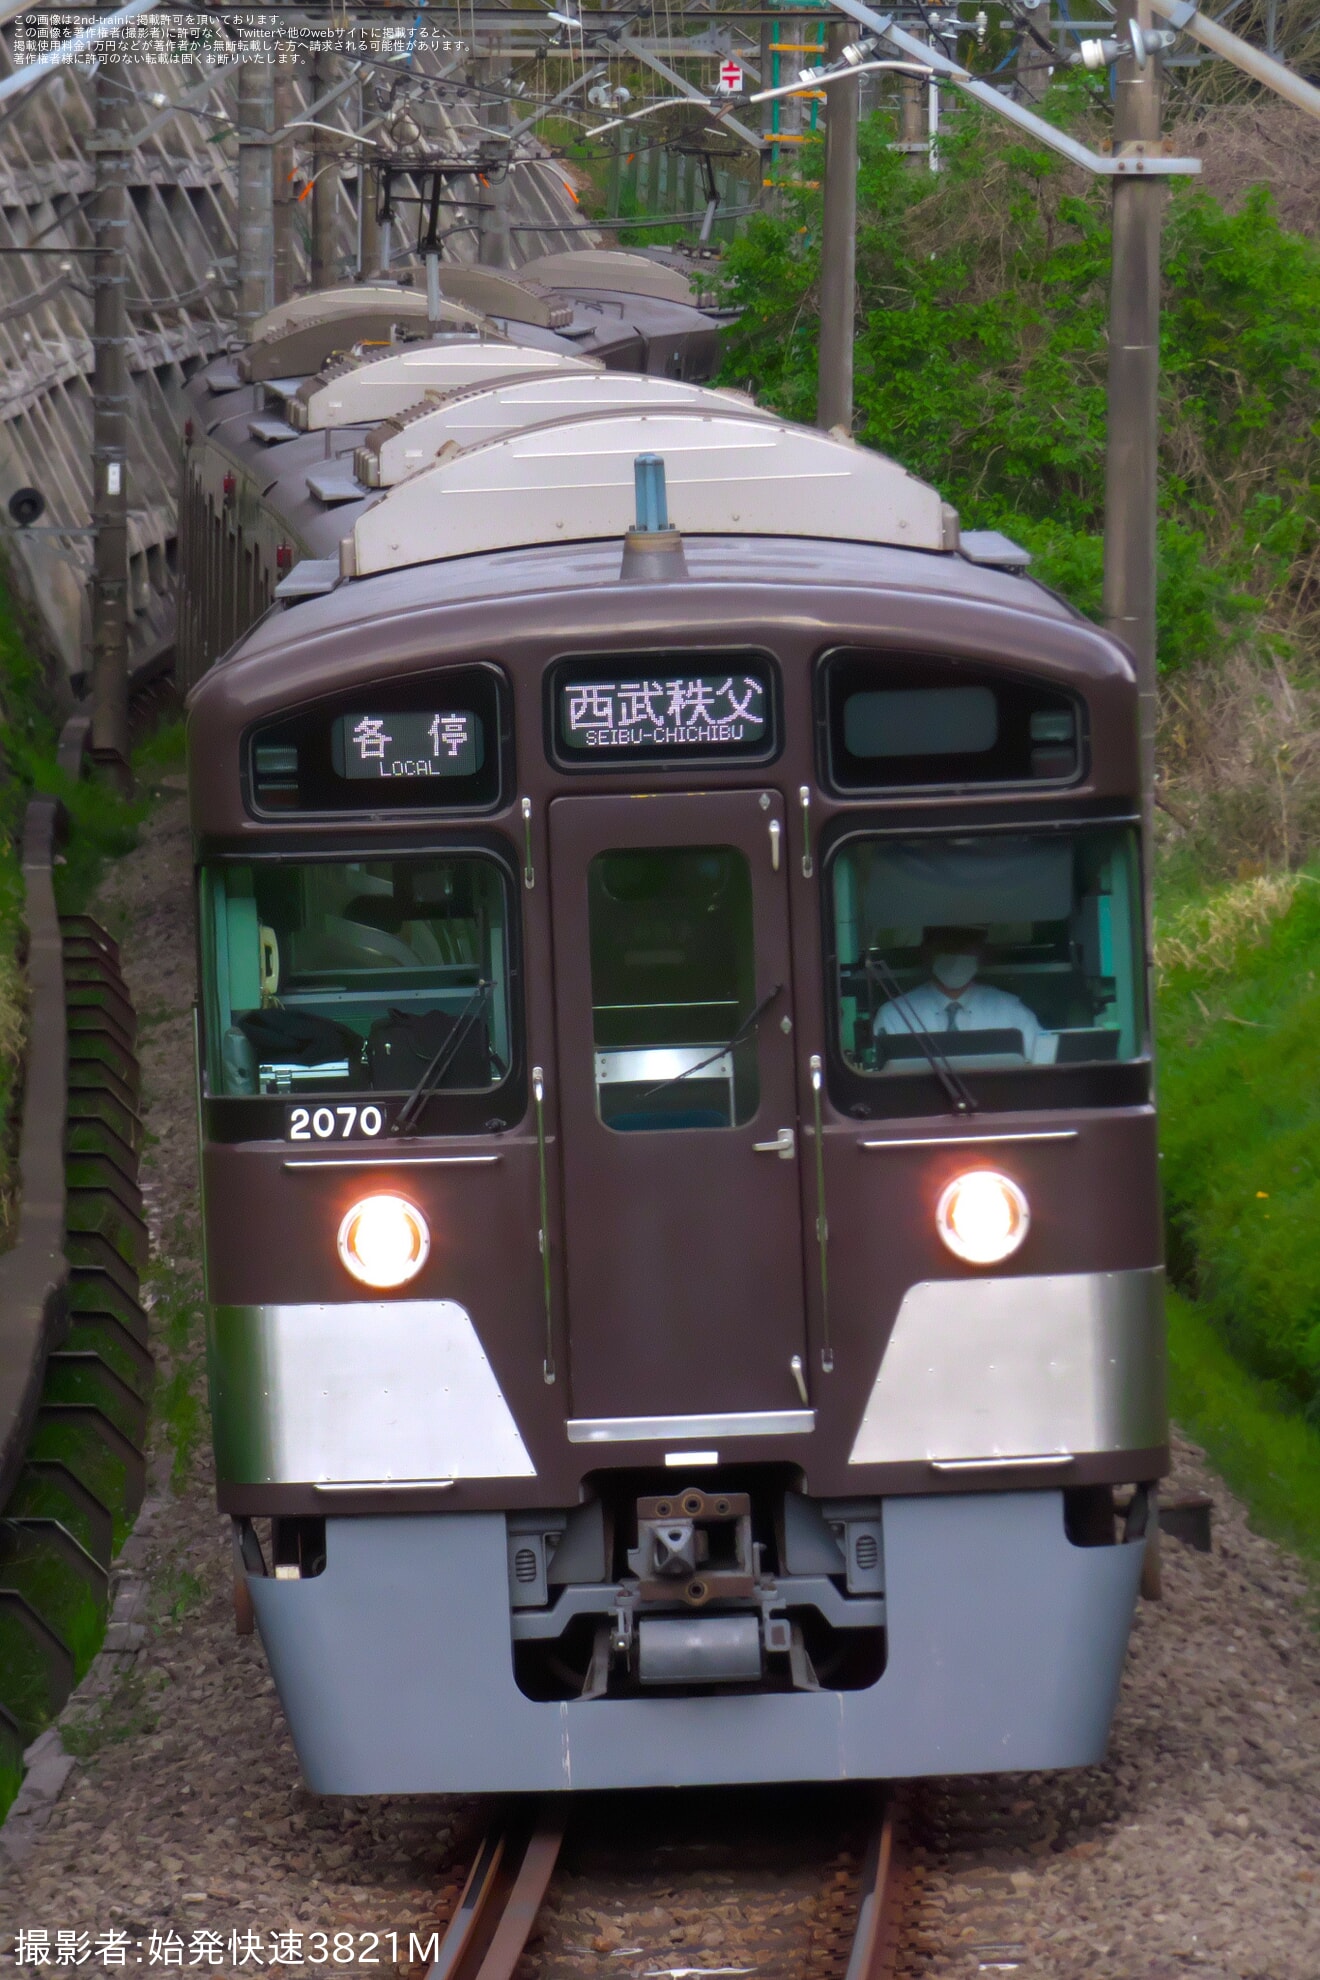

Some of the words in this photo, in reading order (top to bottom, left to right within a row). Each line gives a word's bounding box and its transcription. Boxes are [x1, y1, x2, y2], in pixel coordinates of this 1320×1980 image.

[565, 677, 764, 729] 西武秩父
[586, 725, 744, 745] SEIBU-CHICHIBU
[379, 760, 440, 777] LOCAL
[290, 1106, 382, 1140] 2070
